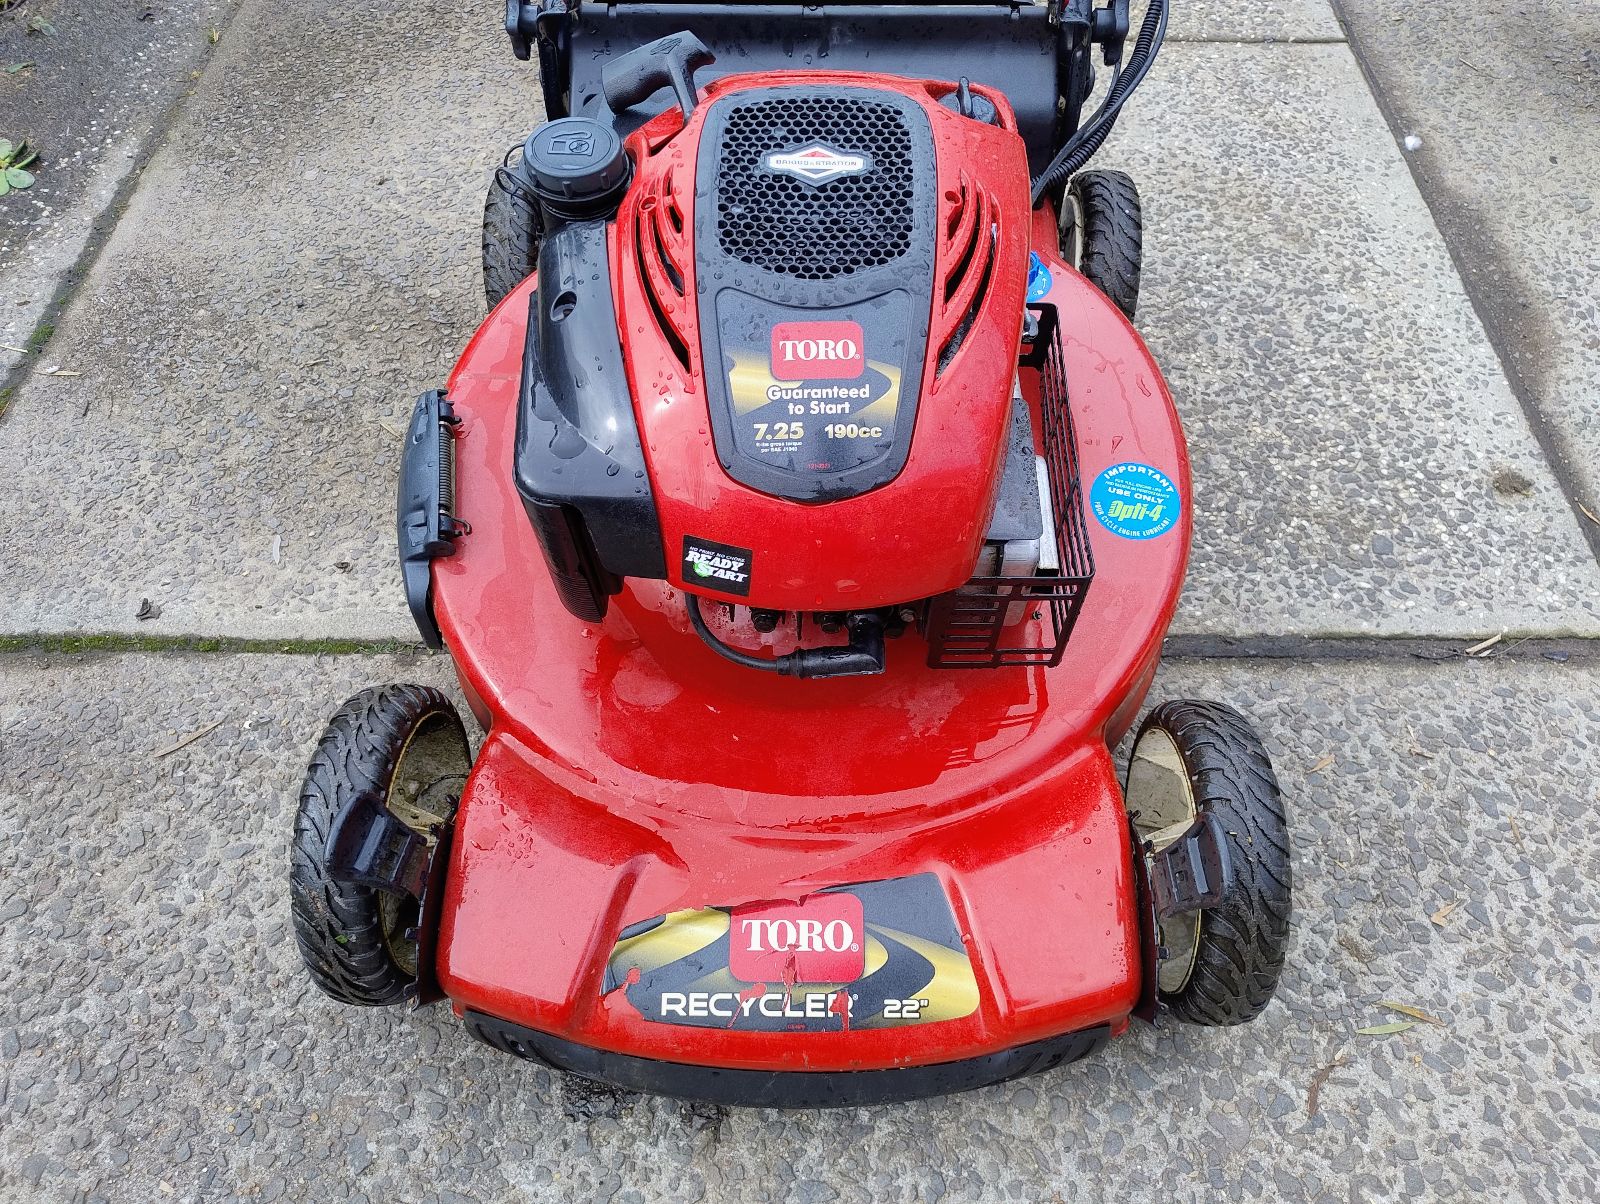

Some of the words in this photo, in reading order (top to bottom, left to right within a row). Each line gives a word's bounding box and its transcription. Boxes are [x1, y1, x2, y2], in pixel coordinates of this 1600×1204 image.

[767, 384, 870, 400] Guaranteed
[788, 402, 805, 415] to
[809, 401, 851, 415] Start
[753, 422, 804, 440] 7.25
[824, 423, 883, 439] 190cc
[1103, 465, 1175, 493] IMPORTANT
[1107, 486, 1132, 497] USE
[1133, 492, 1165, 504] ONLY
[1108, 500, 1164, 522] Opti-4
[1101, 515, 1119, 531] CYCLE
[1118, 527, 1141, 537] ENGINE
[1142, 517, 1172, 537] LUBRICANT
[685, 551, 745, 572] READY
[697, 562, 749, 583] START
[883, 999, 929, 1018] 22"
